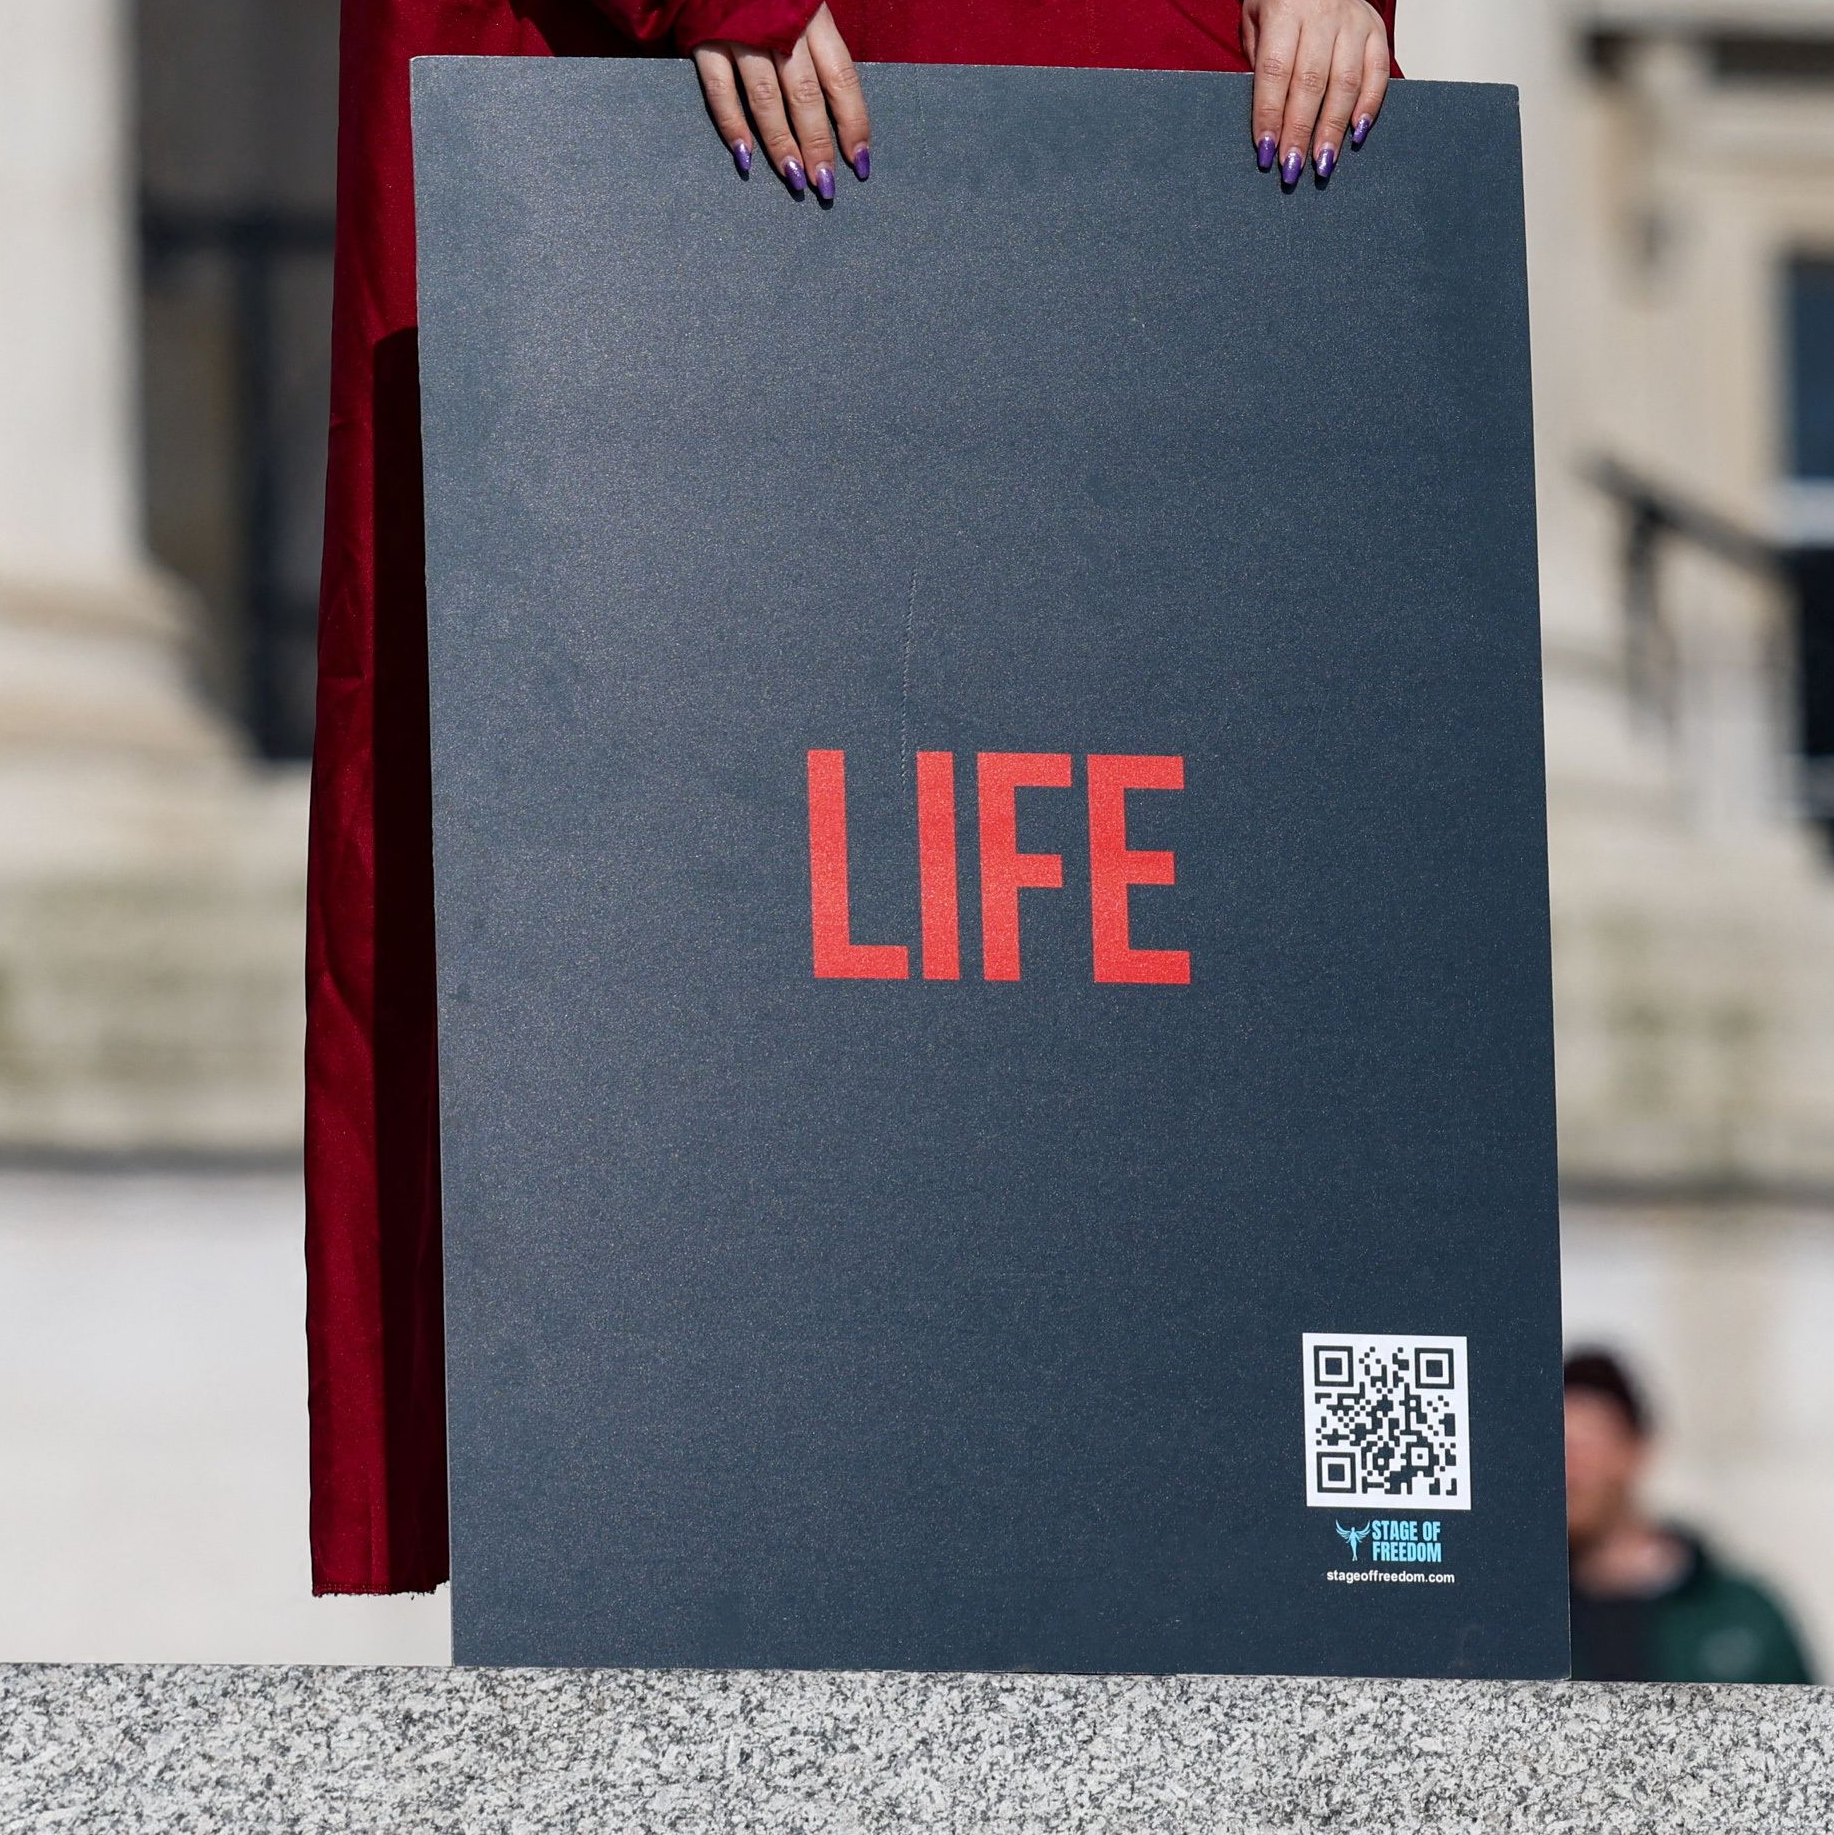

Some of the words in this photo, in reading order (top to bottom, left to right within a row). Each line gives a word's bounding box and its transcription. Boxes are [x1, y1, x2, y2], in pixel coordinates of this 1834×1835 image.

[806, 748, 1191, 985] LIFE
[1371, 1520, 1418, 1541] STAGE
[1423, 1521, 1441, 1541] OF
[1372, 1541, 1442, 1563] FREEDOM
[1326, 1569, 1456, 1585] stageoffreedom.com
